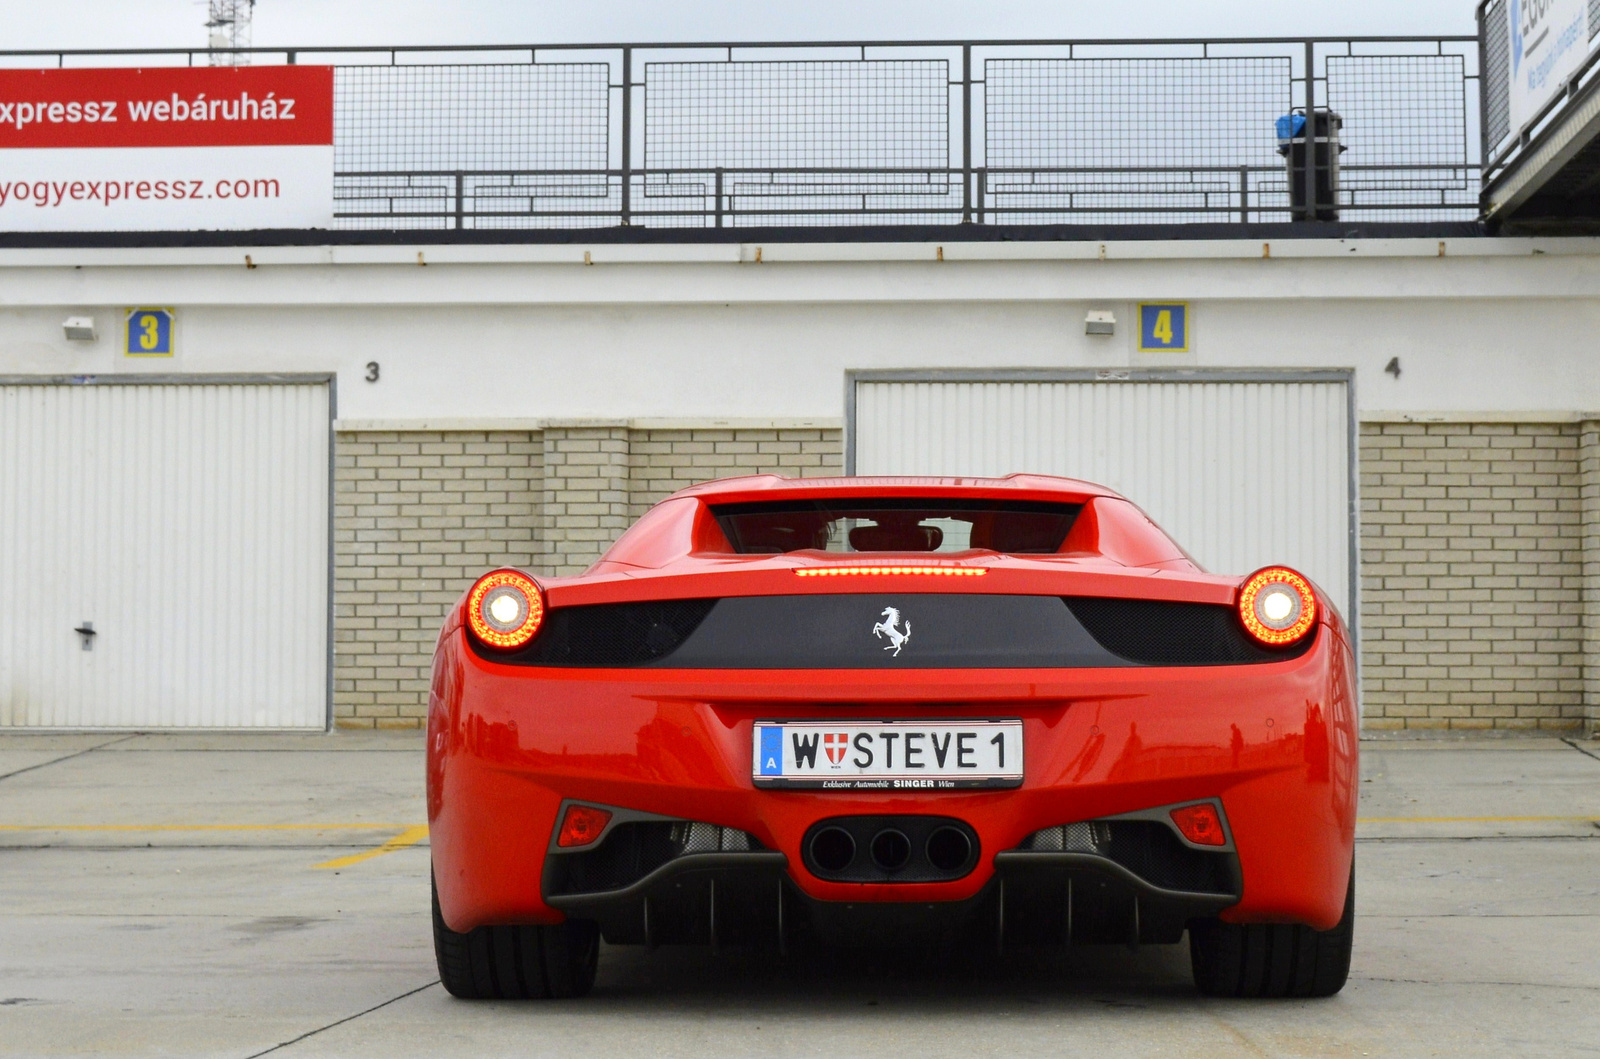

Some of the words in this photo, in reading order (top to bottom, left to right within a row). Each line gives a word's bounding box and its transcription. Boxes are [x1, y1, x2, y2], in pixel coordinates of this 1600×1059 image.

[0, 101, 117, 130] xpressz
[128, 92, 296, 122] webáruház
[0, 178, 280, 207] yogyexpressz.com
[140, 315, 158, 350] 3
[1153, 310, 1173, 344] 4
[365, 361, 380, 382] 3
[1384, 356, 1402, 379] 4
[766, 757, 777, 769] A
[792, 732, 820, 769] W
[853, 732, 978, 769] STEVE
[990, 732, 1005, 768] 1
[822, 780, 851, 788] Exklusive
[853, 780, 890, 788] Automobile
[893, 779, 935, 788] SINGER
[938, 780, 955, 788] Wien
